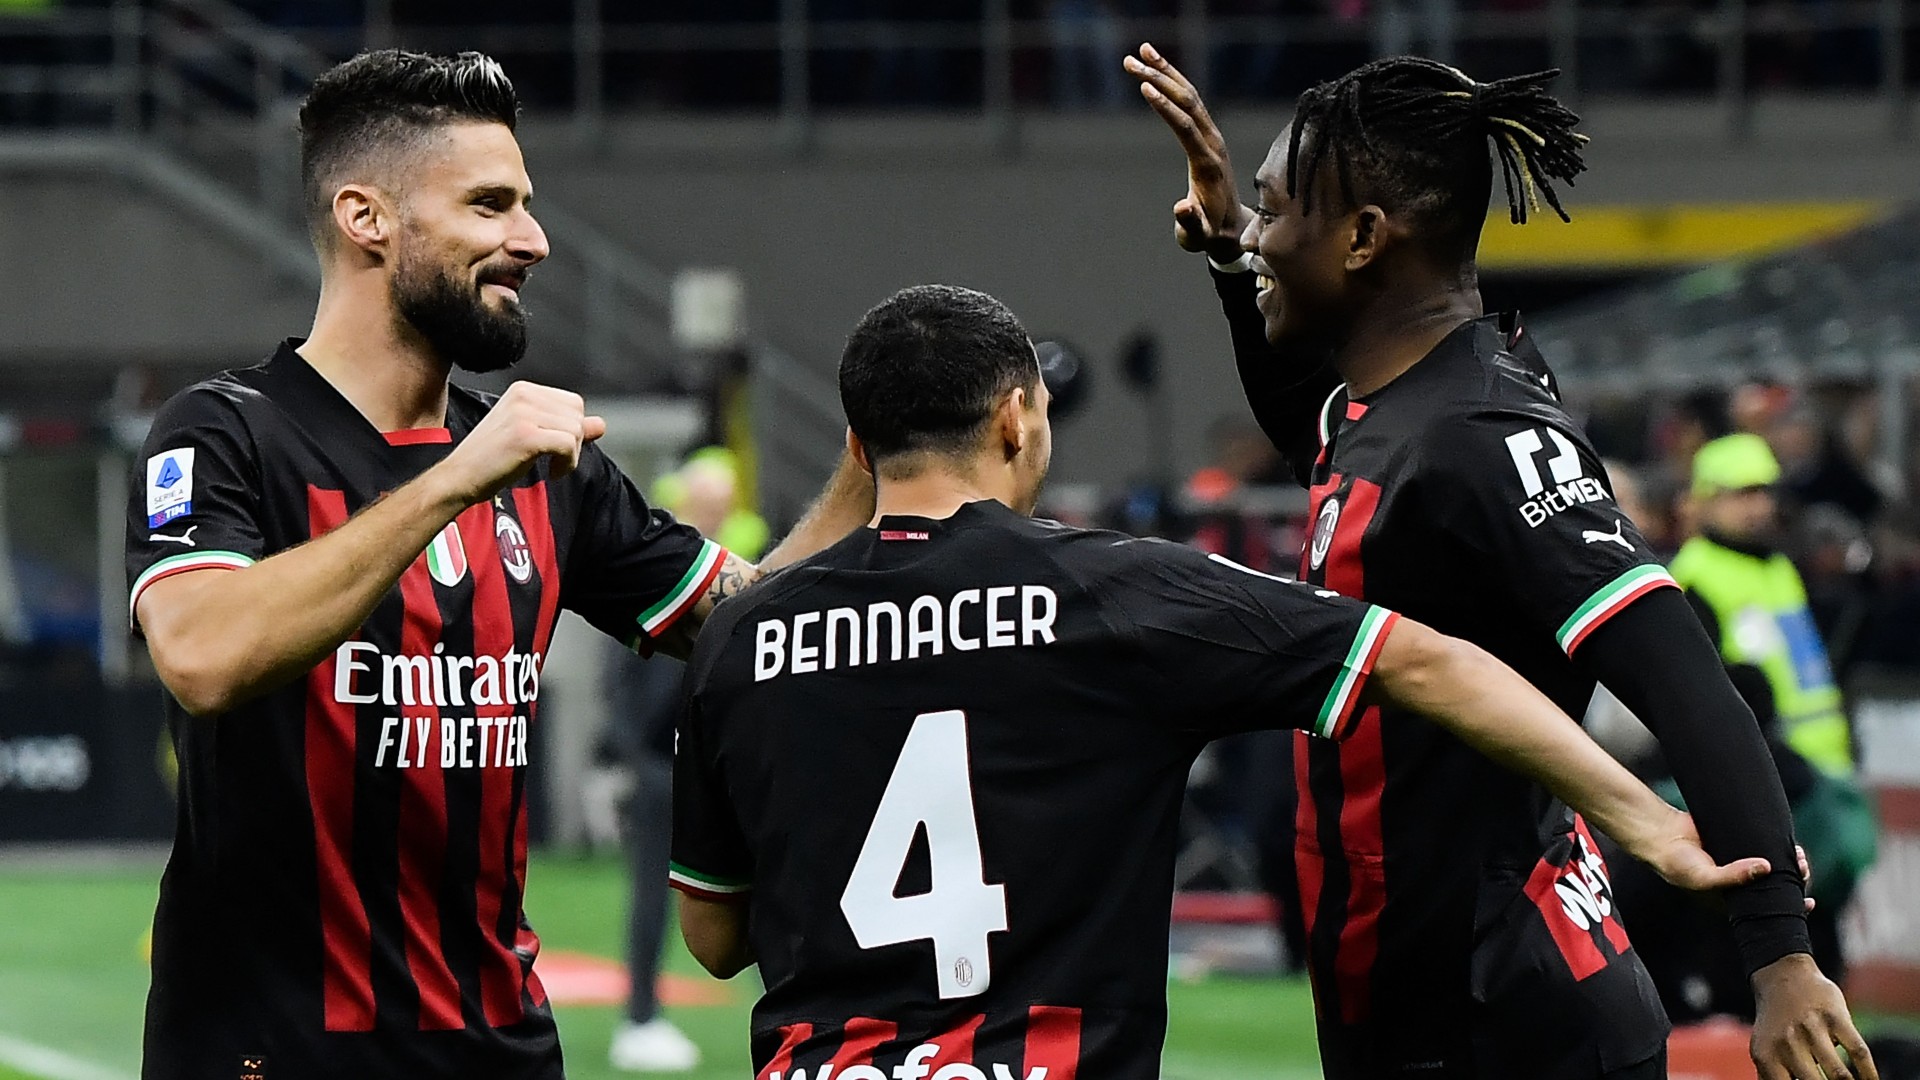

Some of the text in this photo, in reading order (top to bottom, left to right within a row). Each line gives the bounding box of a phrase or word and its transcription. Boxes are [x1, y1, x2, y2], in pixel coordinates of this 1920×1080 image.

[165, 503, 185, 518] TIM
[1519, 477, 1610, 528] BitMEX
[754, 585, 1057, 682] BENNACER
[334, 641, 541, 706] Emirates
[375, 715, 528, 768] FLY BETTER
[840, 709, 1008, 999] 4
